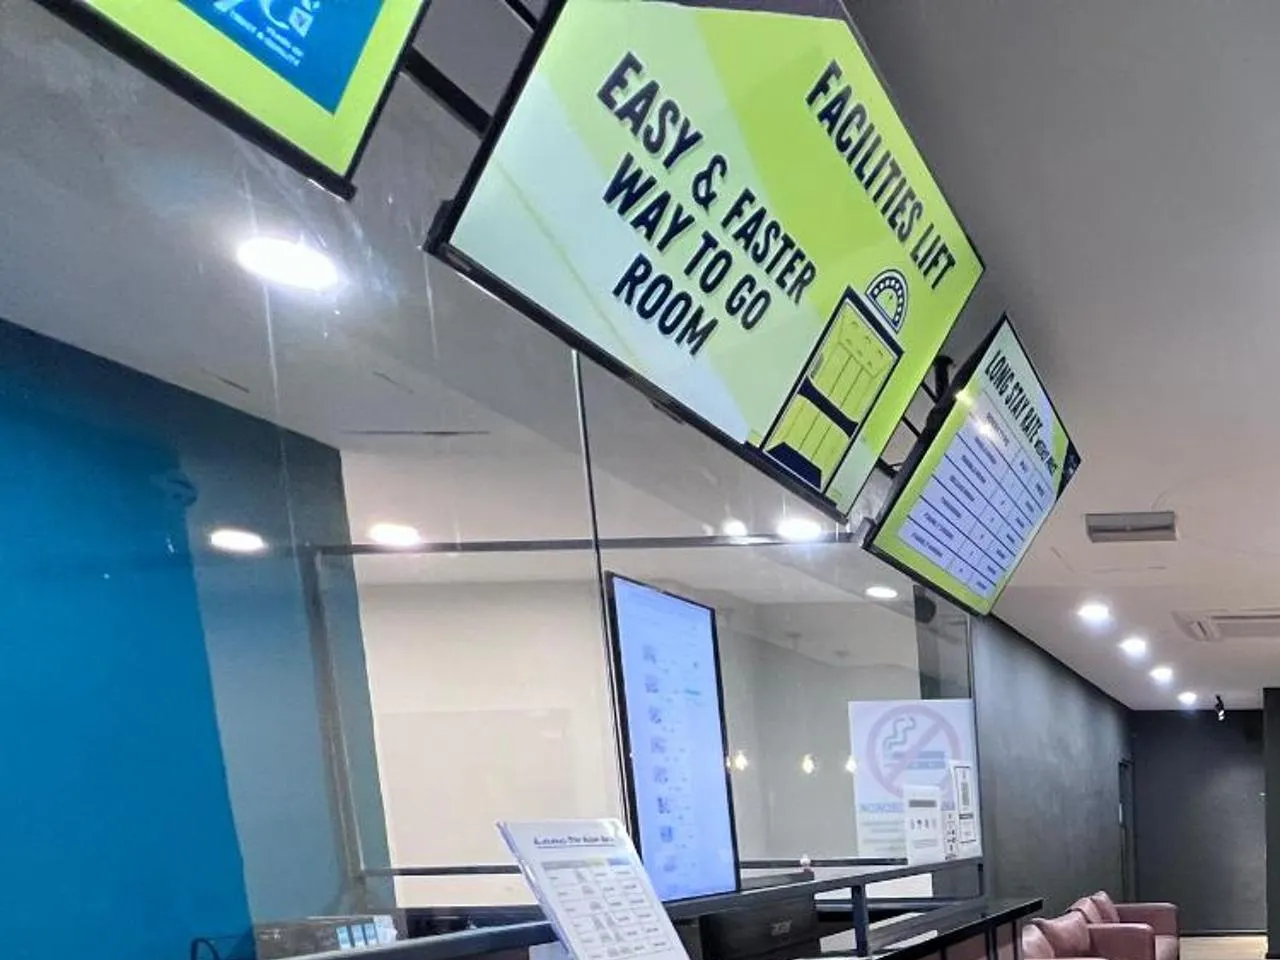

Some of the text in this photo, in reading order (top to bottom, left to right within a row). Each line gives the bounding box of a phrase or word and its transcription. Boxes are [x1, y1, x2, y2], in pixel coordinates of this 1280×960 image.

[597, 51, 816, 304] EASY & FASTER
[602, 152, 771, 330] WAY TO GO
[806, 58, 956, 290] FACILITIES LIFT
[612, 253, 718, 356] ROOM
[985, 350, 1015, 396] LONG
[1005, 380, 1030, 421] STAY
[1019, 407, 1043, 443] RATE
